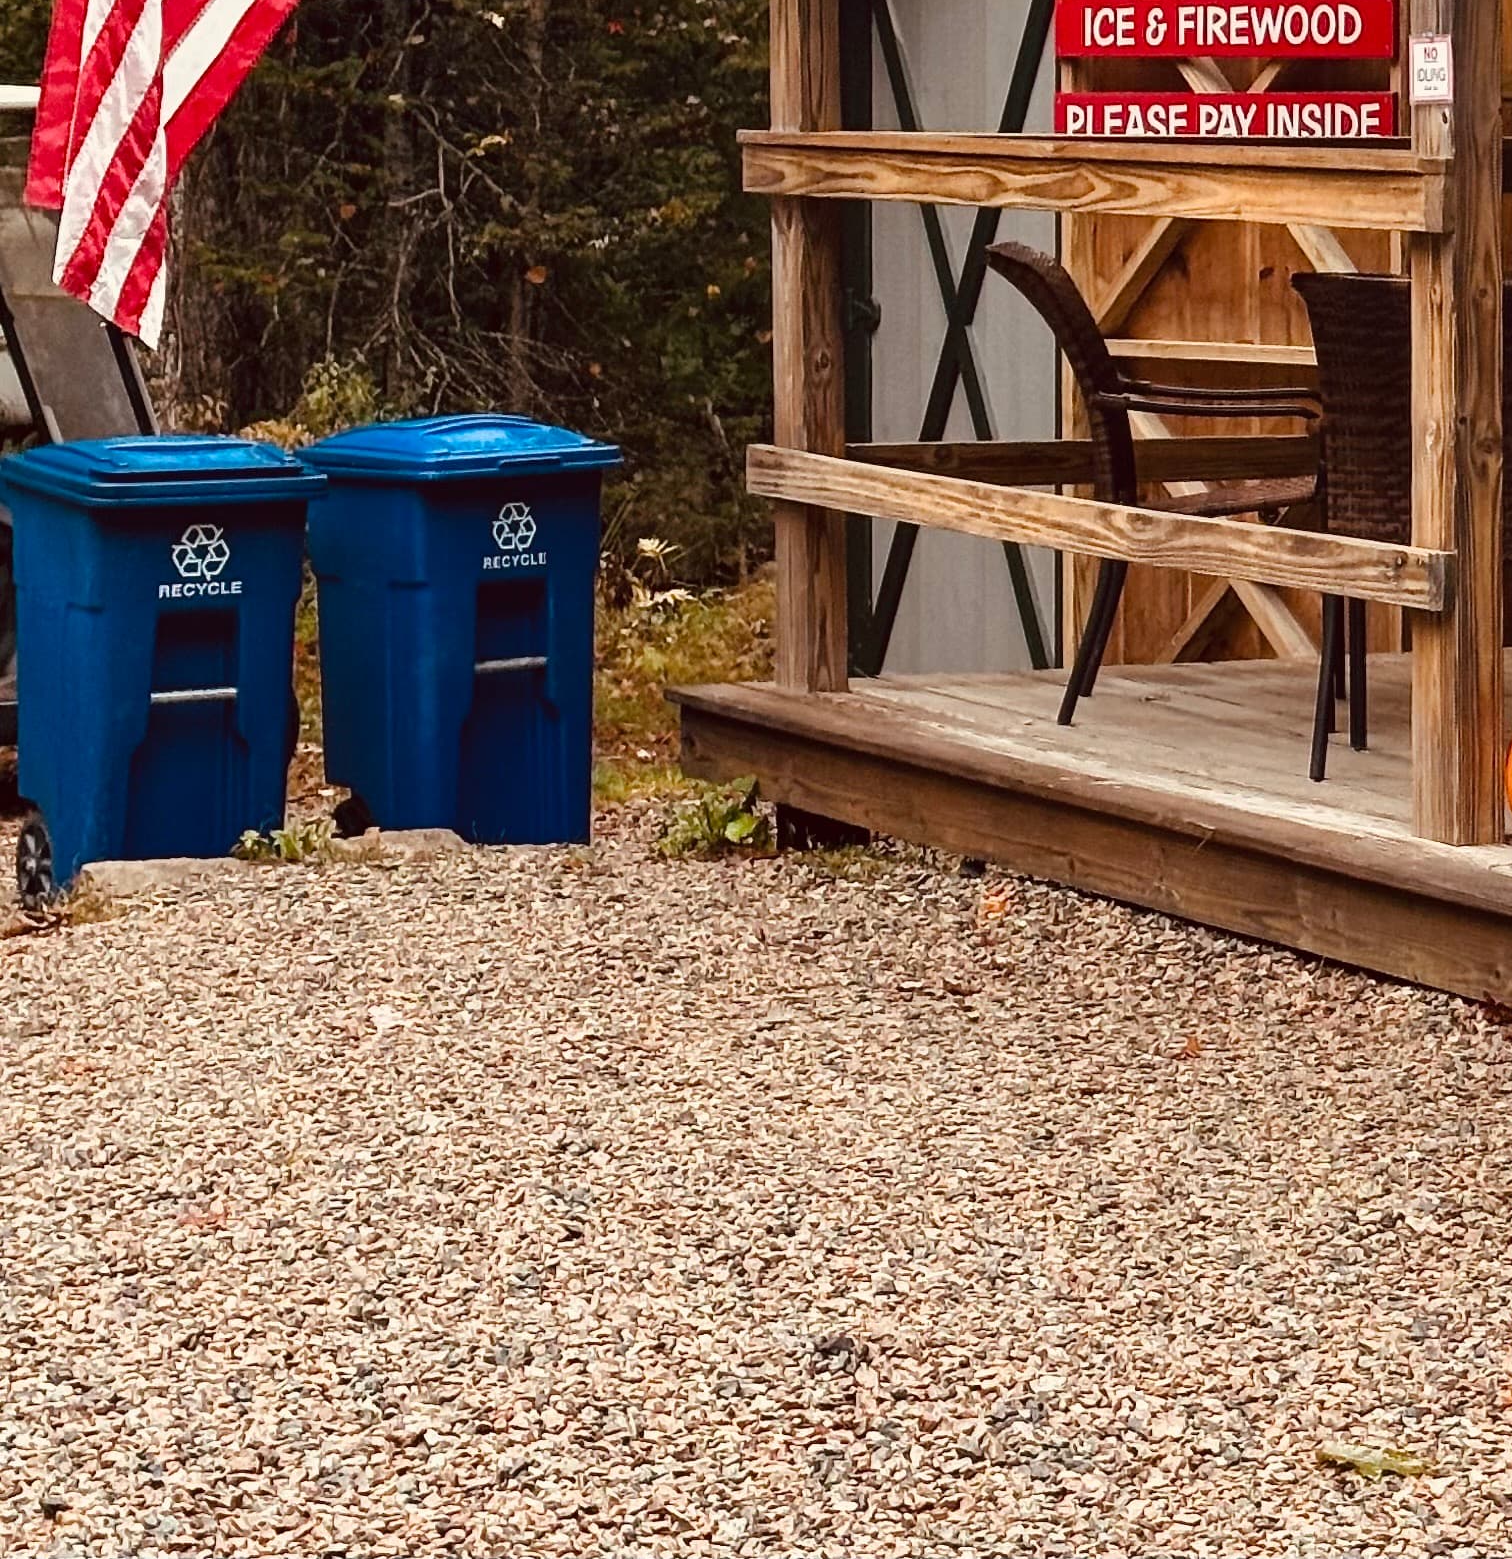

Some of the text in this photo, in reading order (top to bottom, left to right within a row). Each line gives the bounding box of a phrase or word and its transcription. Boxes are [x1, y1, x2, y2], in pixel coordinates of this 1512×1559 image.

[1084, 4, 1363, 47] ICE & FIREWOOD
[1424, 46, 1439, 60] NO
[1066, 102, 1381, 138] PLEASE PAY INSIDE
[482, 552, 547, 570] RECYCLE
[158, 581, 243, 599] RECYCLE
